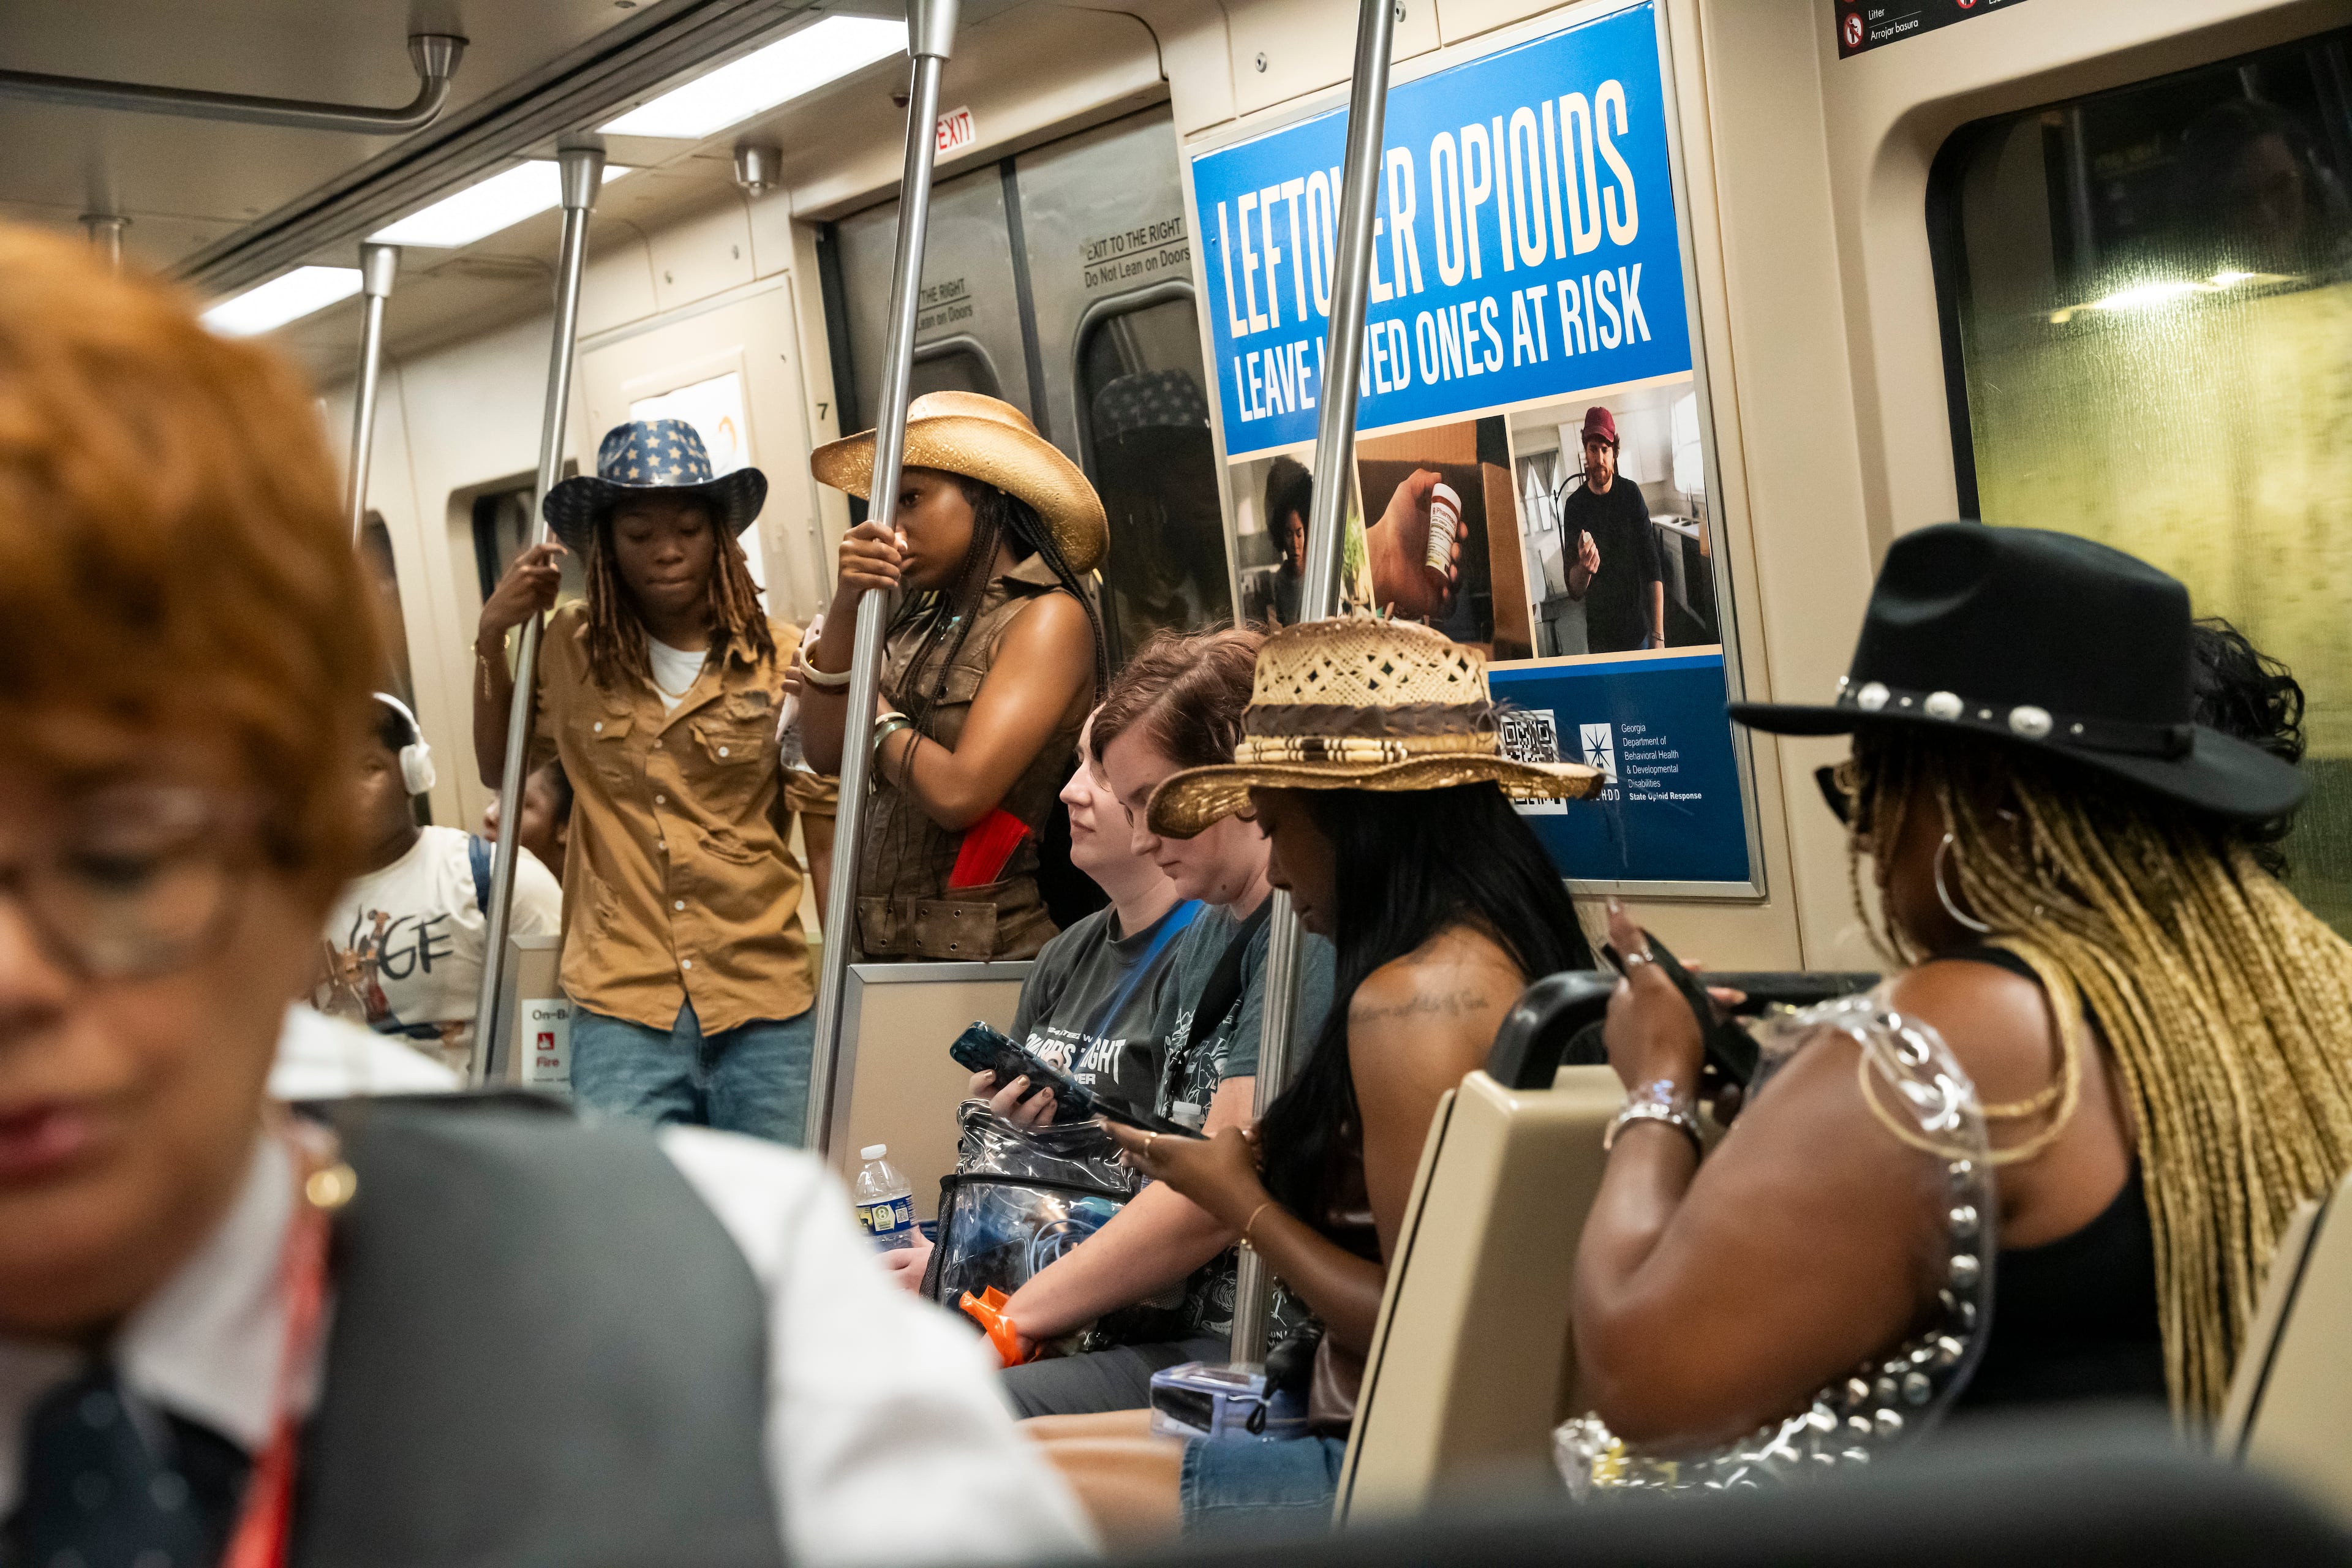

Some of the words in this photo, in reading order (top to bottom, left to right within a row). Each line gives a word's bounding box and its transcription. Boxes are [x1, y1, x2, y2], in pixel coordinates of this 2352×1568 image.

[1868, 8, 1885, 21] Litter
[1871, 25, 1894, 40] Arrojar
[1895, 19, 1918, 33] basura
[937, 112, 970, 149] EXIT
[1430, 79, 1638, 287] OPIOIDS
[1110, 235, 1124, 253] TO
[1125, 228, 1147, 248] THE
[1149, 217, 1181, 243] RIGHT
[1084, 271, 1099, 288] Do
[1099, 265, 1117, 284] Not
[1118, 262, 1144, 278] Lean
[1145, 257, 1158, 271] on
[1159, 246, 1191, 267] Doors
[1234, 339, 1316, 423] LEAVE
[1415, 296, 1504, 385] ONES
[1512, 284, 1549, 367] AT
[1557, 263, 1652, 356] RISK
[816, 403, 829, 421] 7
[1621, 723, 1646, 734] Georgia
[1623, 737, 1659, 748] Department
[1660, 736, 1667, 745] of
[1624, 750, 1657, 761] Behavioral
[1659, 749, 1679, 760] Health
[1626, 765, 1632, 774] &
[1632, 764, 1679, 775] Developmental
[1628, 778, 1661, 788] Disabilities
[1648, 792, 1668, 802] Opioid
[1670, 791, 1702, 801] Response
[536, 1056, 560, 1068] Fire
